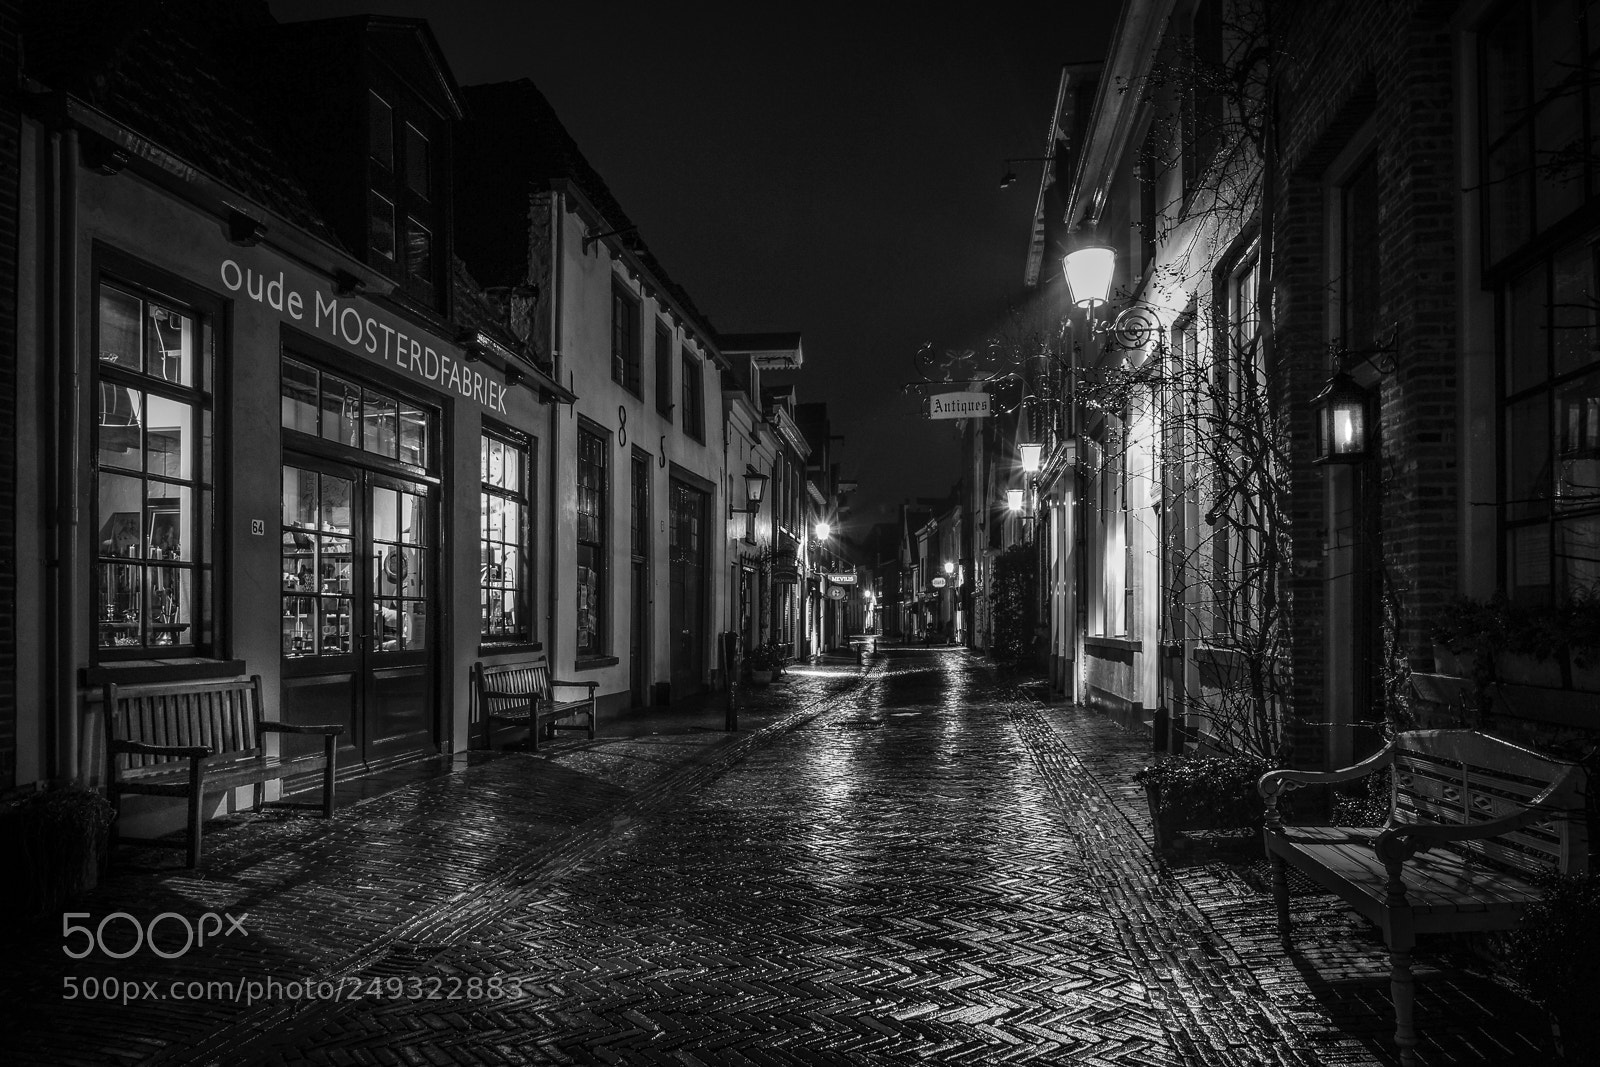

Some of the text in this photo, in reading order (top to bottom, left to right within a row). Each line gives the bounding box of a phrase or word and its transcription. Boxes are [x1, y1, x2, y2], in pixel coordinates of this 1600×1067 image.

[220, 259, 508, 415] oude MOSTERDFABRIEK
[933, 399, 988, 414] Antiques
[252, 521, 264, 534] 64
